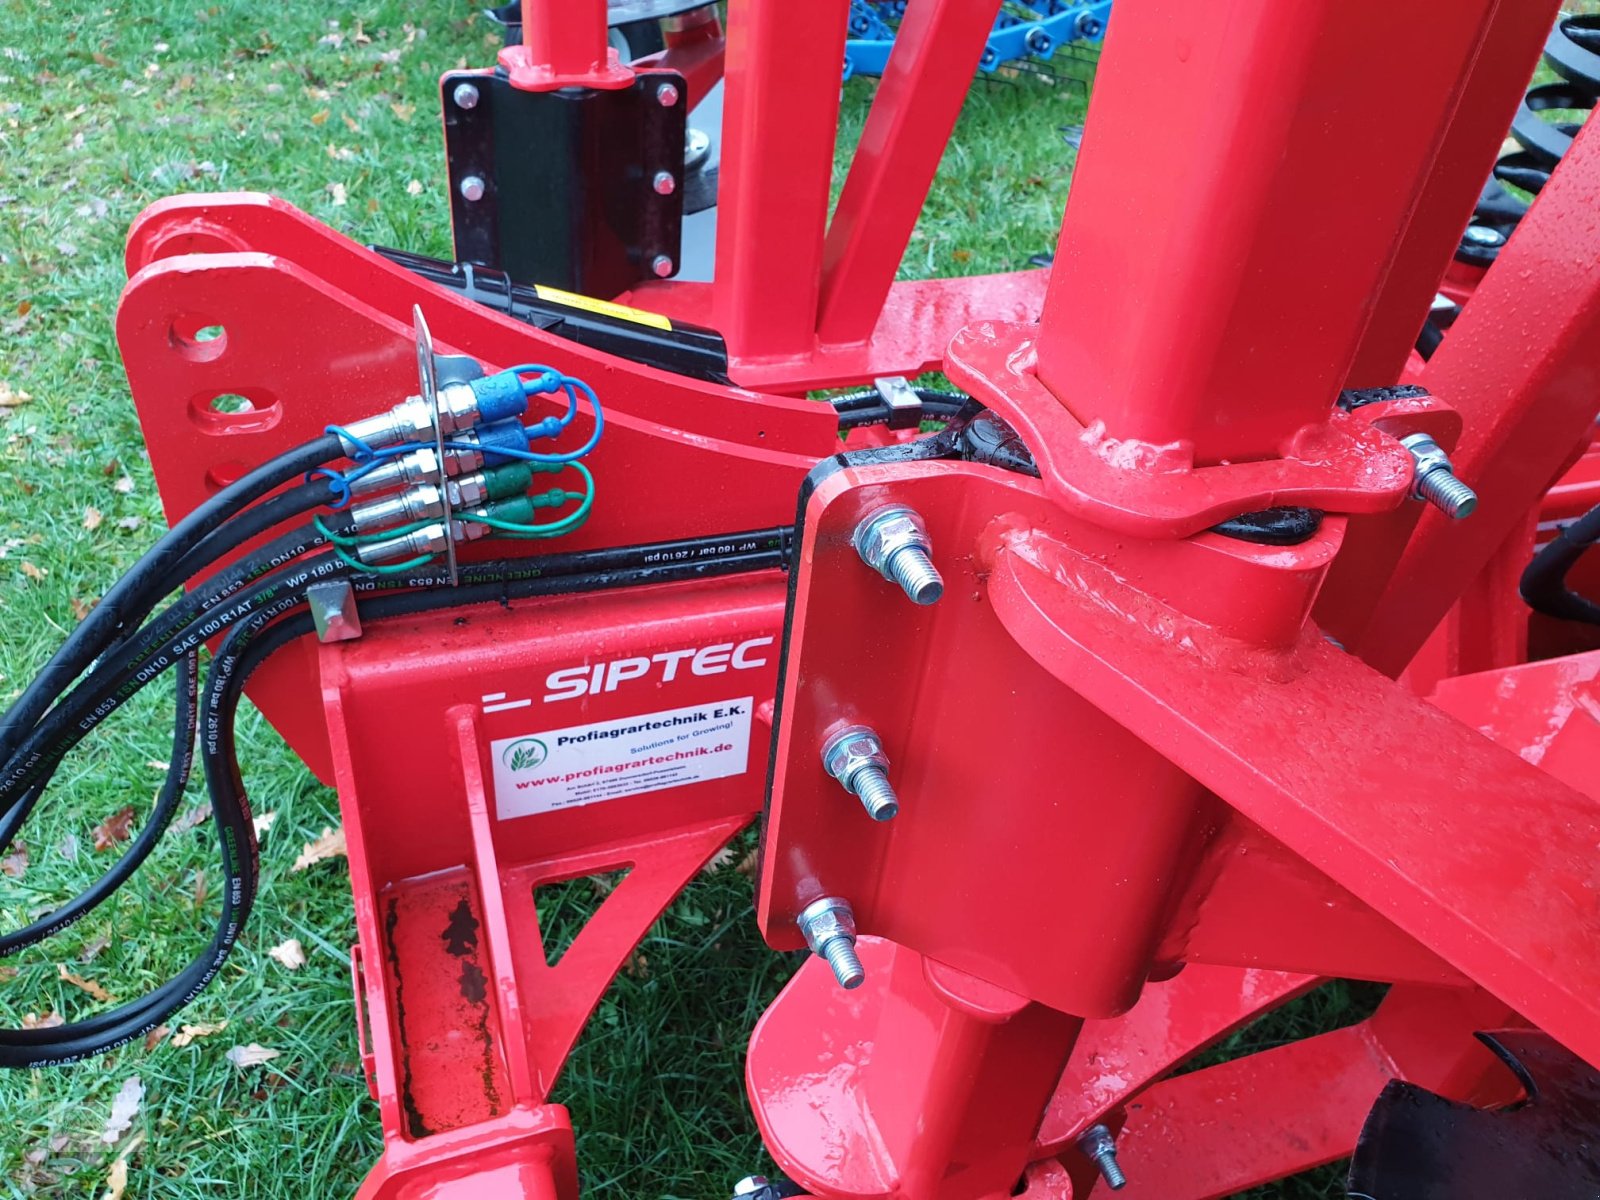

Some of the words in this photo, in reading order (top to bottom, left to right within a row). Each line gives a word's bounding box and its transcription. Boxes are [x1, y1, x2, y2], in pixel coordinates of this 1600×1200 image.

[662, 550, 689, 561] 2610
[699, 546, 716, 555] bar
[739, 542, 756, 551] WP
[644, 553, 660, 563] psi
[222, 580, 245, 597] 853
[271, 545, 306, 568] DN10
[409, 577, 433, 587] 853
[278, 596, 299, 611] 100
[250, 607, 280, 633] R1AT
[79, 713, 98, 730] EN
[95, 697, 117, 716] 853
[116, 677, 141, 699] 1SN
[136, 656, 169, 682] DN10
[173, 634, 200, 655] SAE
[199, 619, 221, 638] 100
[220, 600, 252, 624] R1AT
[286, 573, 308, 588] WP
[311, 563, 334, 578] 180
[543, 636, 774, 702] SIPTEC
[214, 673, 227, 692] 180
[210, 691, 222, 708] bar
[207, 716, 219, 741] 2610
[557, 712, 708, 746] Profiagrartechnik
[713, 705, 746, 719] E.K.
[630, 737, 675, 755] Solutions
[677, 733, 690, 742] for
[692, 721, 734, 738] Growing!
[207, 741, 217, 756] psi
[515, 742, 734, 790] www.profiagrartechnik.de
[231, 877, 242, 889] EN
[231, 889, 242, 905] 853
[223, 922, 239, 944] DN10
